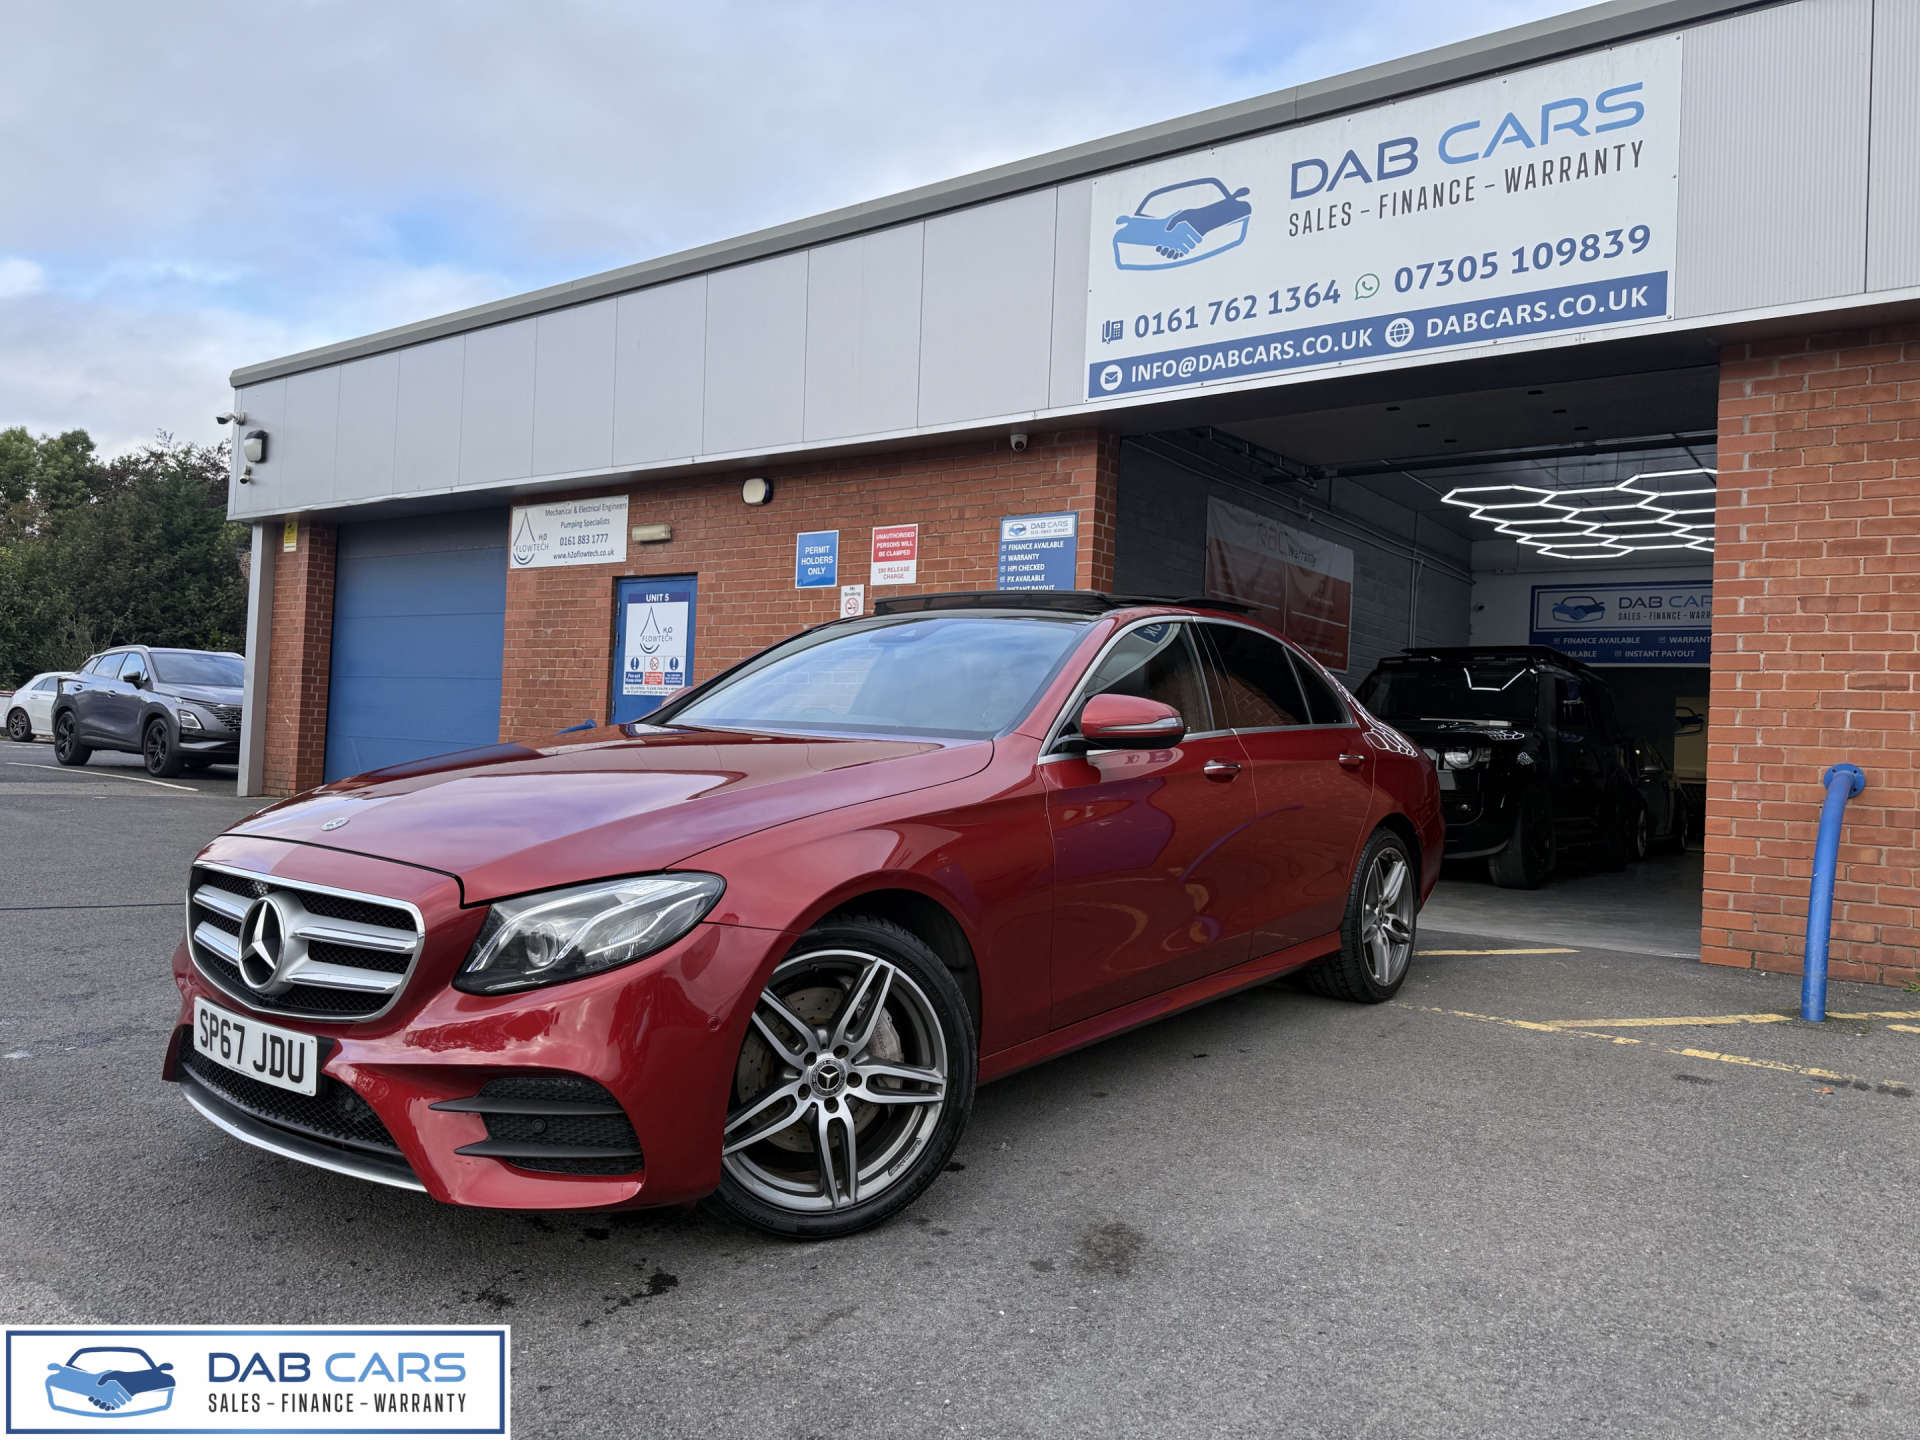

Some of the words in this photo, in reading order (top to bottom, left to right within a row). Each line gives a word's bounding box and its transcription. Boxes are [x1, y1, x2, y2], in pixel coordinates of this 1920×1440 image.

[1290, 136, 1419, 200] DAB
[1438, 81, 1645, 165] CARS
[1289, 201, 1352, 237] SALES
[1378, 175, 1476, 219] FINANCE
[1504, 140, 1644, 194] WARRANTY
[1394, 251, 1499, 293] 07305
[1511, 224, 1651, 274] 109839
[1134, 305, 1199, 338] 0161
[1208, 295, 1258, 325] 762
[1267, 279, 1341, 316] 1364
[1426, 285, 1649, 338] DABCARS.CO.UK
[1130, 327, 1373, 383] INFO@DABCARS.CO.UK
[560, 520, 583, 528] Pumping
[559, 536, 576, 546] 0161
[577, 535, 590, 545] 883
[591, 533, 609, 544] 1777
[804, 545, 831, 555] PERMIT
[1008, 542, 1033, 551] FINANCE
[1033, 541, 1064, 549] AVAILABLE
[801, 555, 834, 565] HOLDERS
[1007, 553, 1040, 561] WARRANTY
[807, 567, 827, 576] ONLY
[1018, 563, 1045, 571] CHECKED
[1015, 574, 1045, 582] AVAILABLE
[645, 593, 664, 602] UNIT
[1619, 596, 1663, 609] DAB
[1668, 595, 1712, 608] CAR
[1617, 611, 1641, 621] SALES
[1649, 610, 1681, 621] FINANCE
[1689, 610, 1711, 620] WARR
[1599, 636, 1641, 644] AVAILABLE
[1669, 636, 1711, 644] WARRANT
[199, 1008, 246, 1065] SP67
[252, 1032, 305, 1084] JDU
